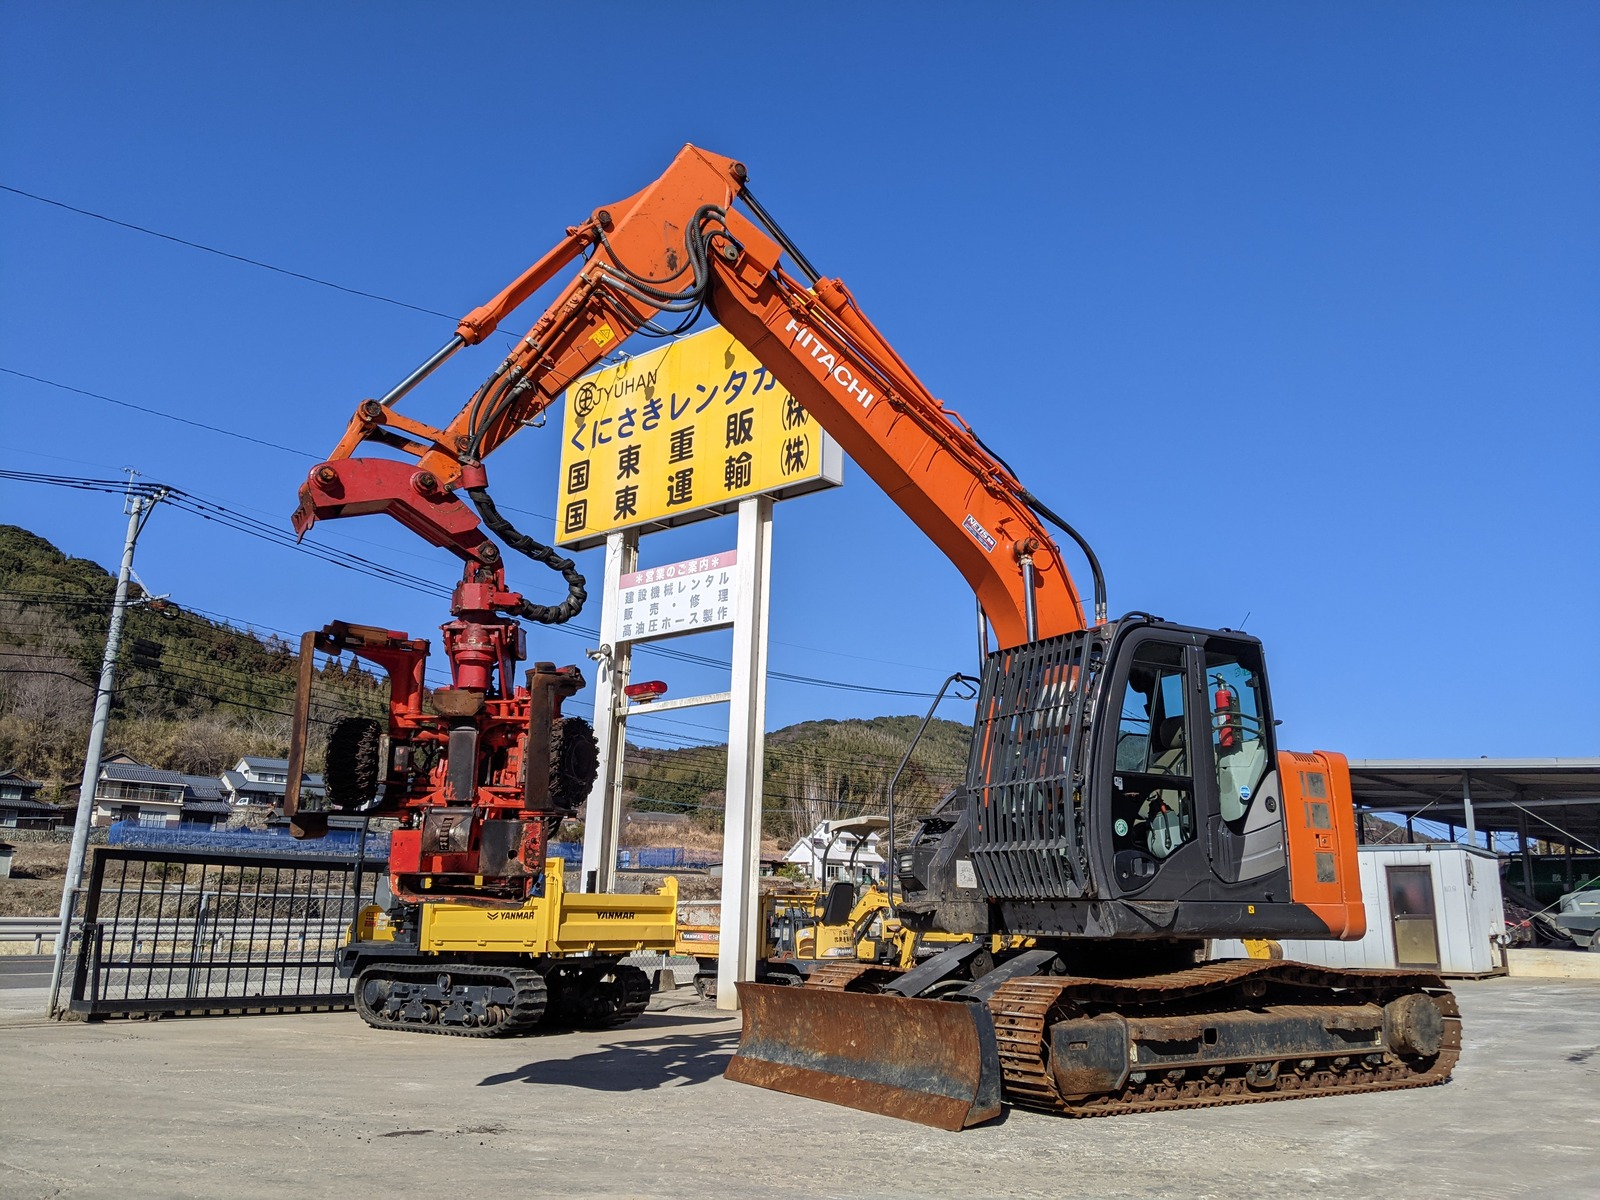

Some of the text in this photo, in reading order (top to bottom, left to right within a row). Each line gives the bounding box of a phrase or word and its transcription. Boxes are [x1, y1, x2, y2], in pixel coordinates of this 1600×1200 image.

[785, 318, 875, 409] HITACHI
[592, 368, 658, 406] JYUHAN
[624, 571, 729, 605] 建設機械レンタル
[622, 606, 728, 638] 高油圧ホース製作
[500, 911, 535, 920] YANMAR
[596, 911, 636, 920] YANMAR
